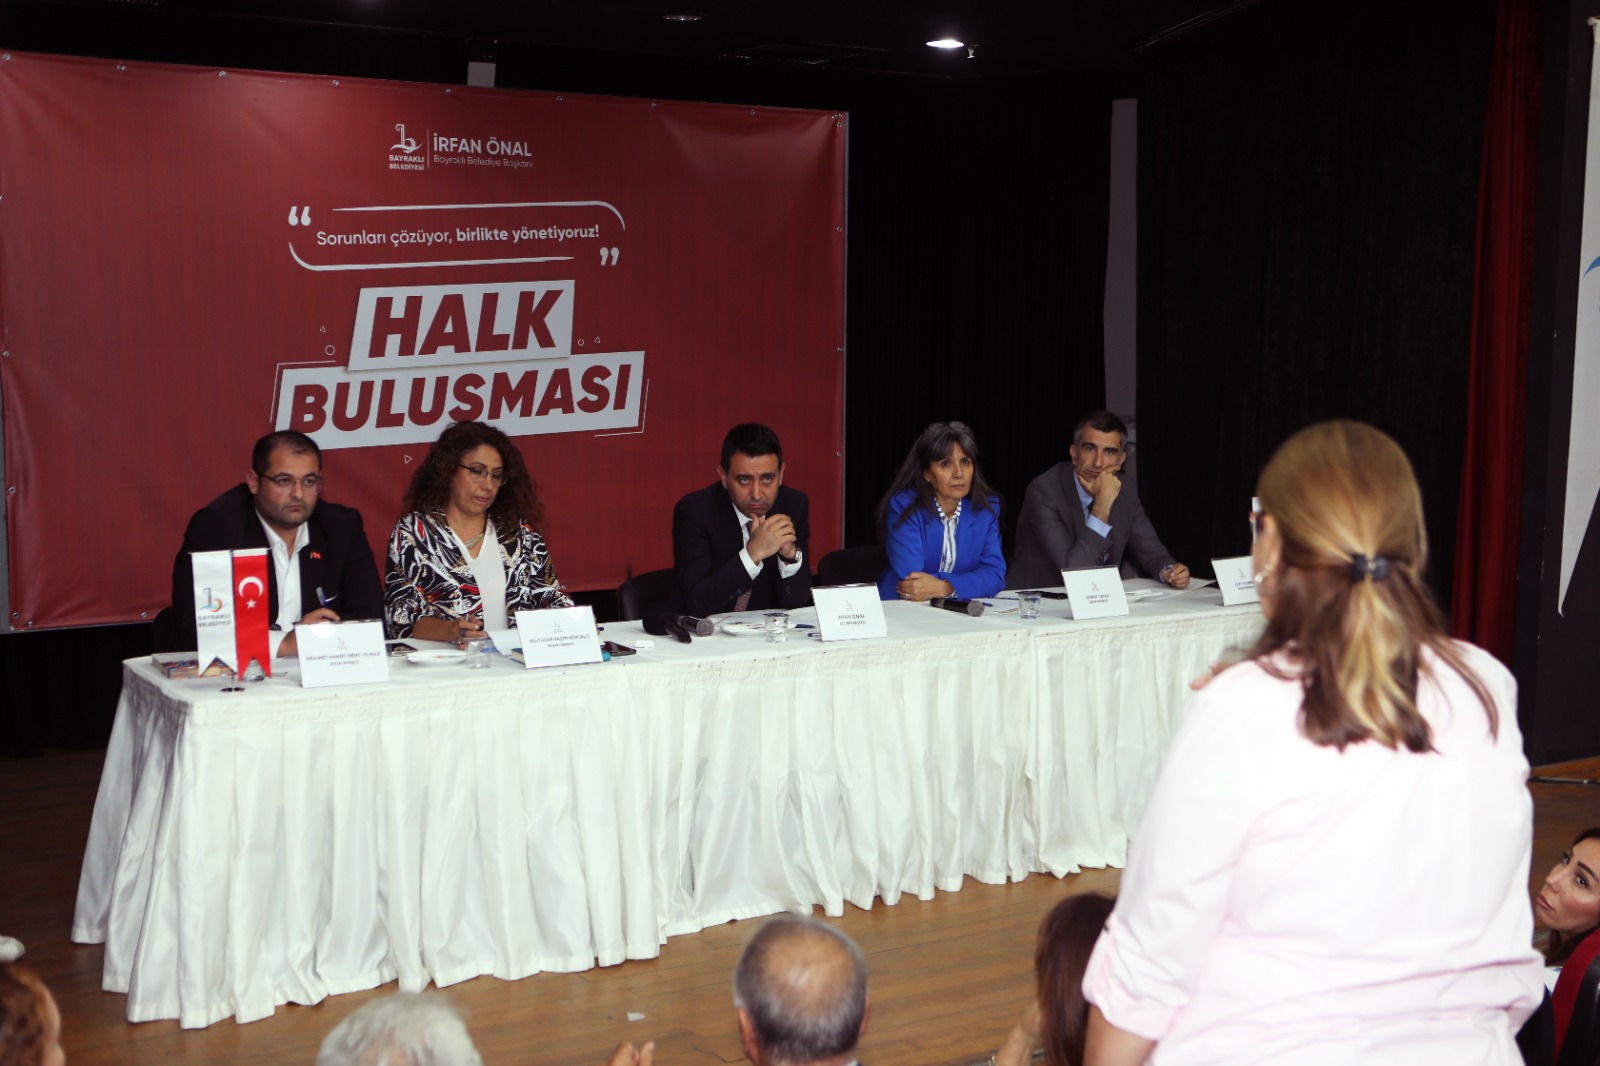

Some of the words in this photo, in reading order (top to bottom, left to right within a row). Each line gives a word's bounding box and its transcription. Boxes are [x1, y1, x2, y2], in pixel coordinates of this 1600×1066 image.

[433, 132, 482, 154] İRFAN
[486, 136, 532, 157] ÖNAL
[389, 154, 424, 163] BAYRAKLI
[389, 163, 424, 171] BELEDİYESİ
[433, 154, 466, 165] Bayraklı
[467, 156, 501, 167] Belediye
[503, 158, 534, 169] Başkanı
[316, 230, 386, 246] Sorunları
[390, 229, 453, 247] çözüyor,
[456, 226, 509, 242] birlikte
[512, 224, 600, 244] yönetiyoruz!
[368, 289, 564, 359] HALK
